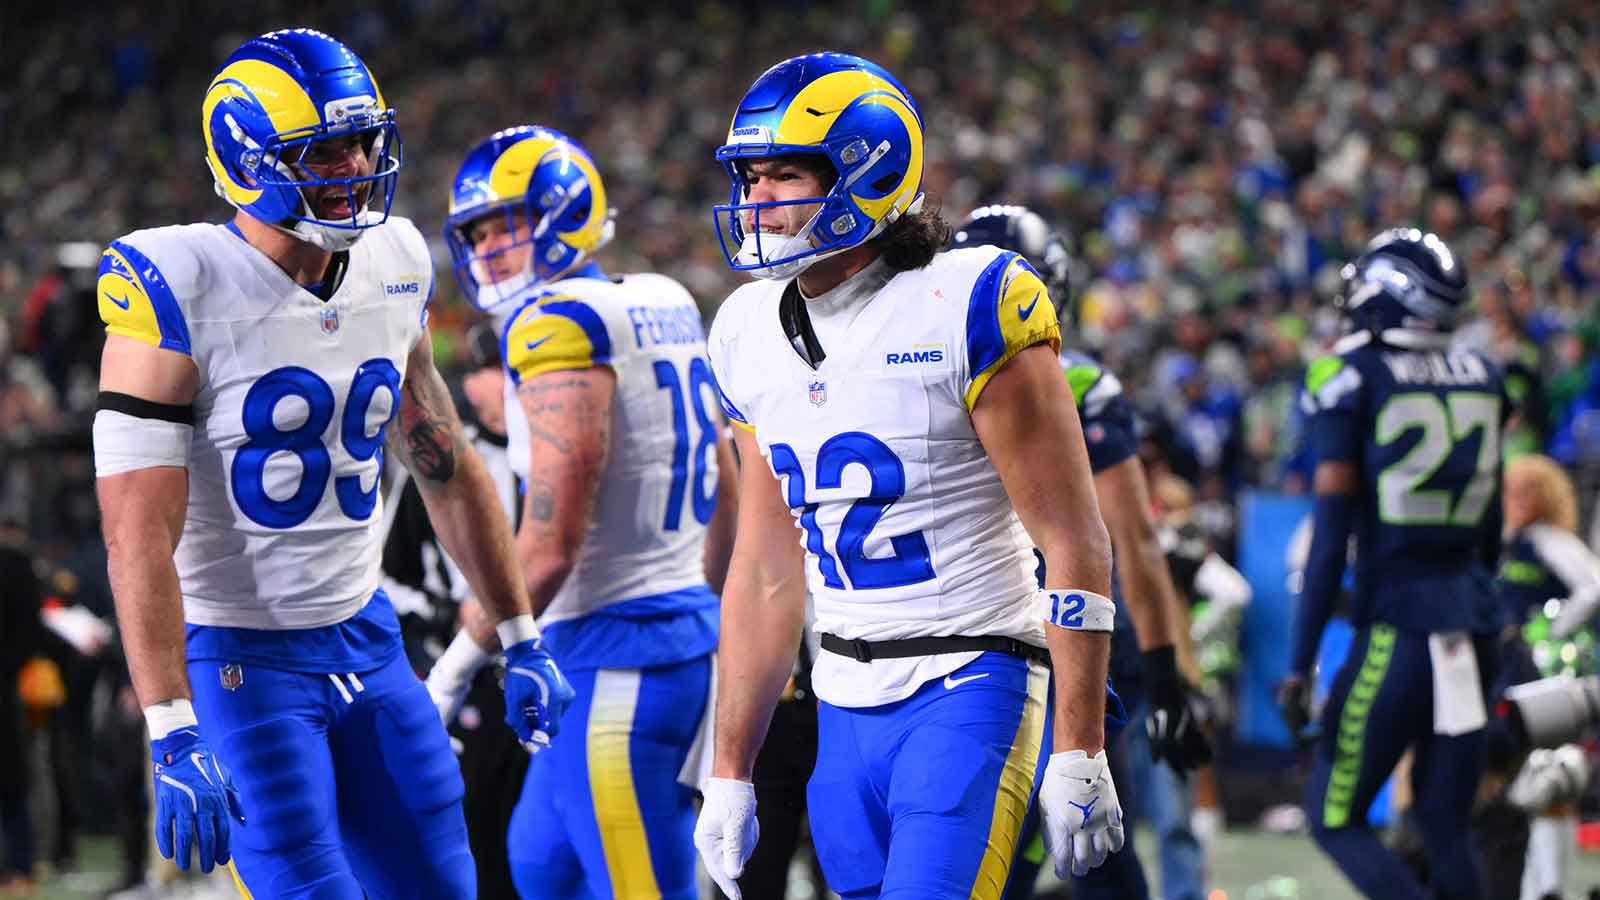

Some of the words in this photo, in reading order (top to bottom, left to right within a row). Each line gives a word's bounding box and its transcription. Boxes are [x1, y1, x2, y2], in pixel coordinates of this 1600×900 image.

[386, 282, 418, 294] RAMS
[886, 350, 943, 364] RAMS
[231, 357, 401, 529] 89
[653, 357, 719, 531] 18
[1375, 391, 1502, 526] 27
[769, 431, 937, 591] 12
[1049, 593, 1086, 628] 12
